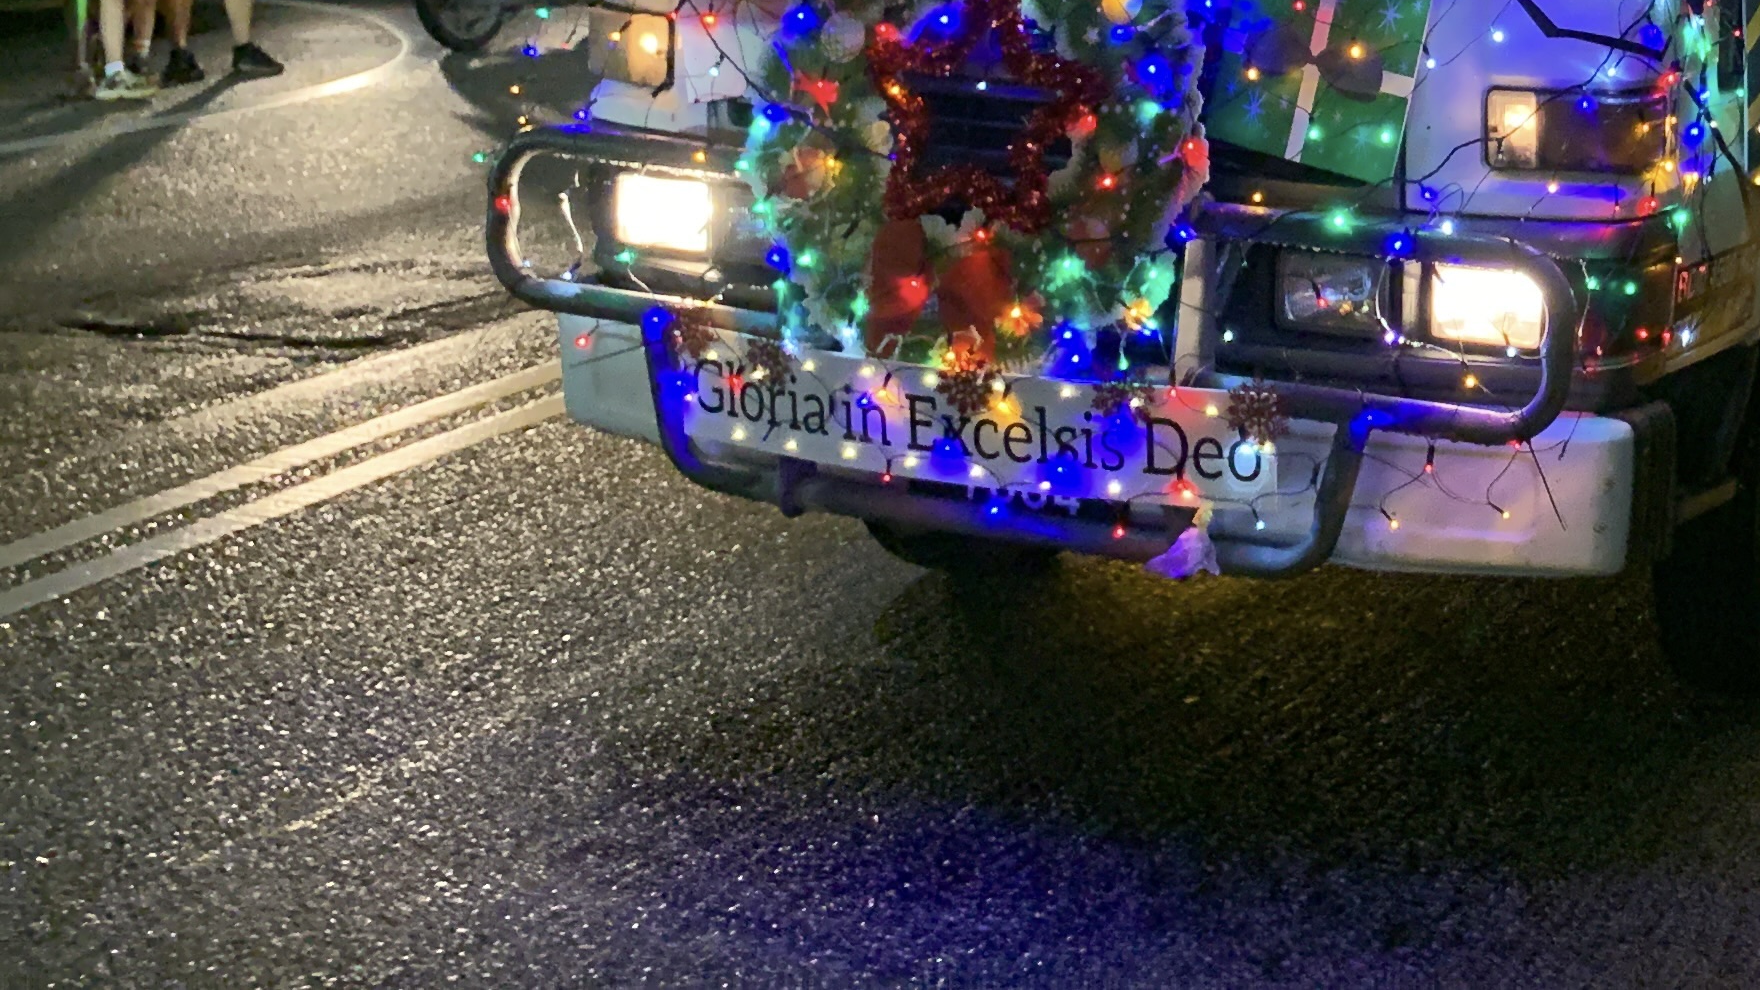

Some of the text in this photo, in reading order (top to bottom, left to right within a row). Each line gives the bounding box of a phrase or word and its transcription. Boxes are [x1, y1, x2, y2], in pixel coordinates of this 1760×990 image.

[696, 359, 1263, 483] Gloria in Excelsis Deo
